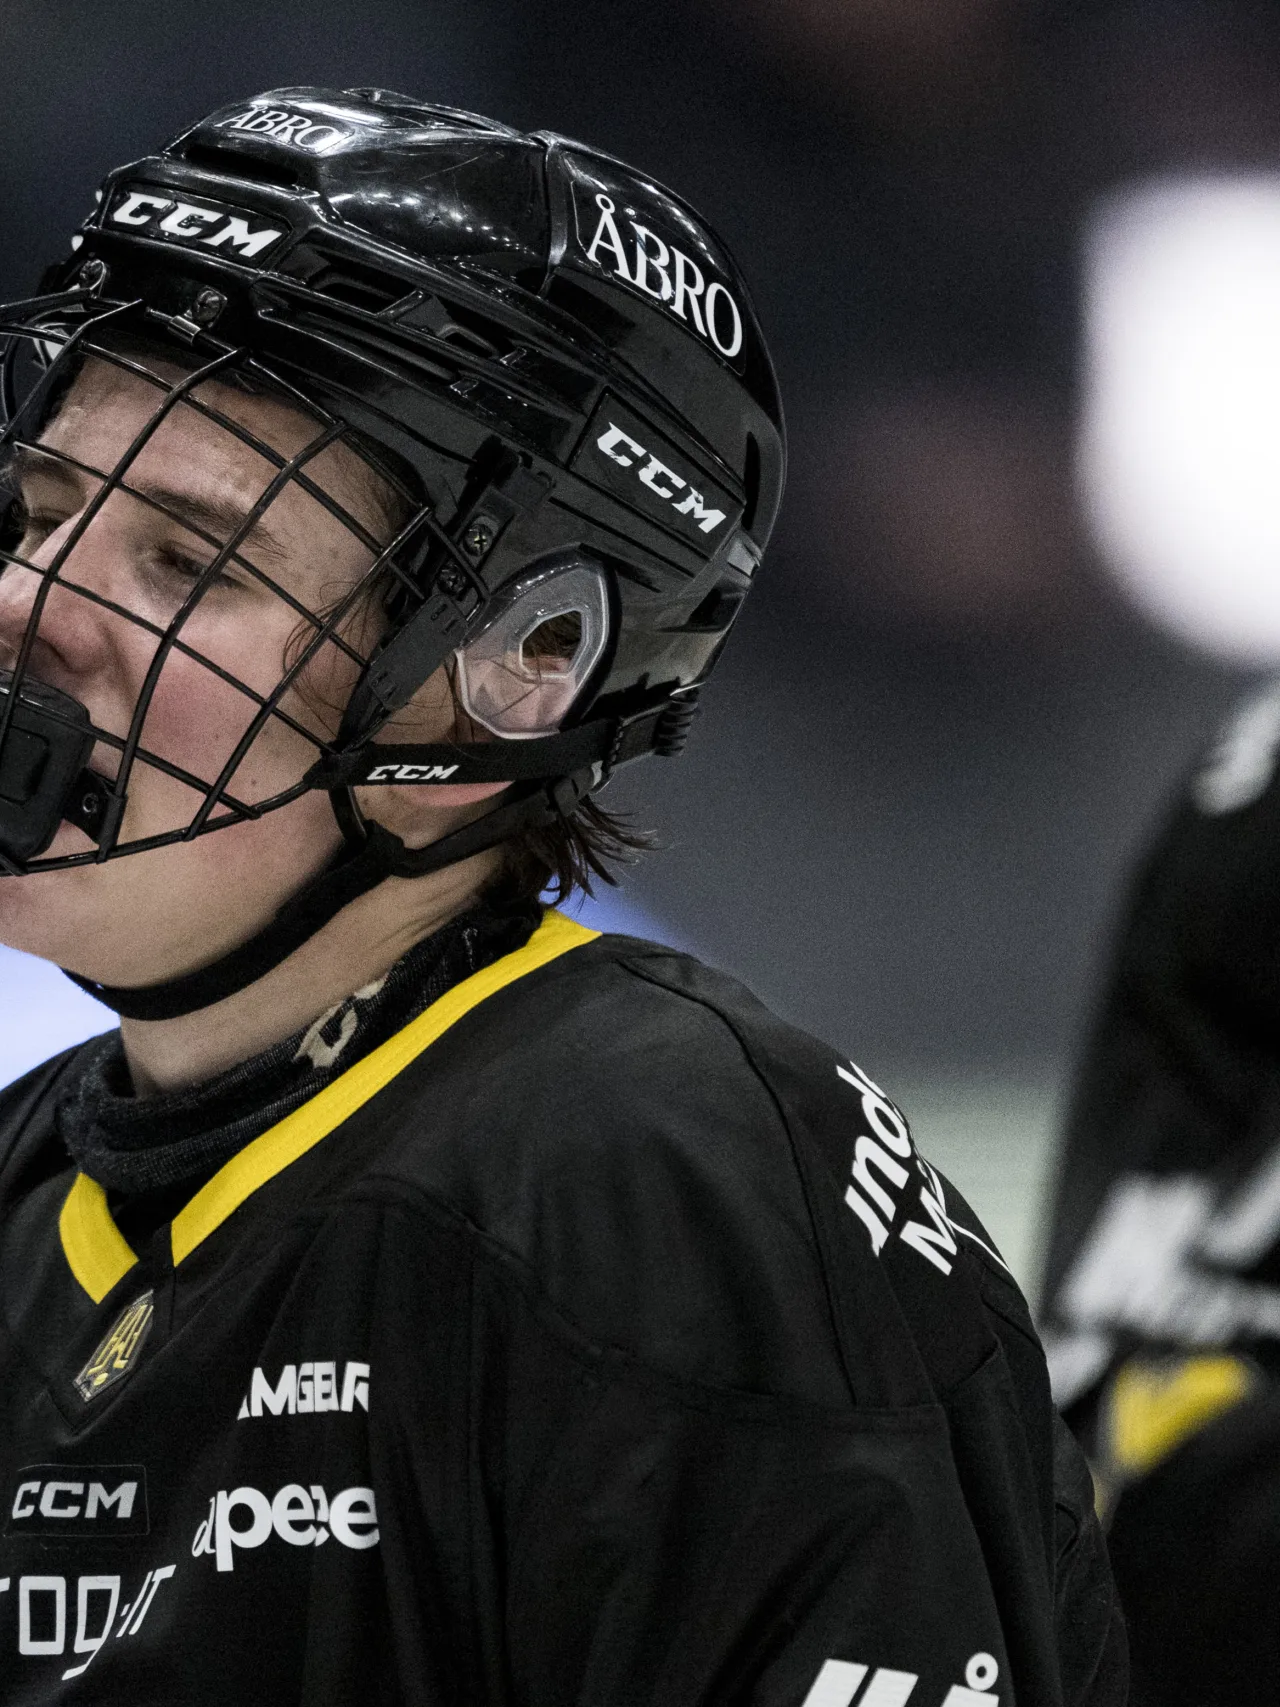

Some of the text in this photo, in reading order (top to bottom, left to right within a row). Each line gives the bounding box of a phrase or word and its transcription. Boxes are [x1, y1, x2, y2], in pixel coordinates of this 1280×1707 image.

[113, 191, 283, 258] CCM
[586, 194, 743, 358] ÅBRO
[596, 421, 727, 534] CCM
[367, 764, 460, 780] CCM
[12, 1481, 138, 1520] CCM
